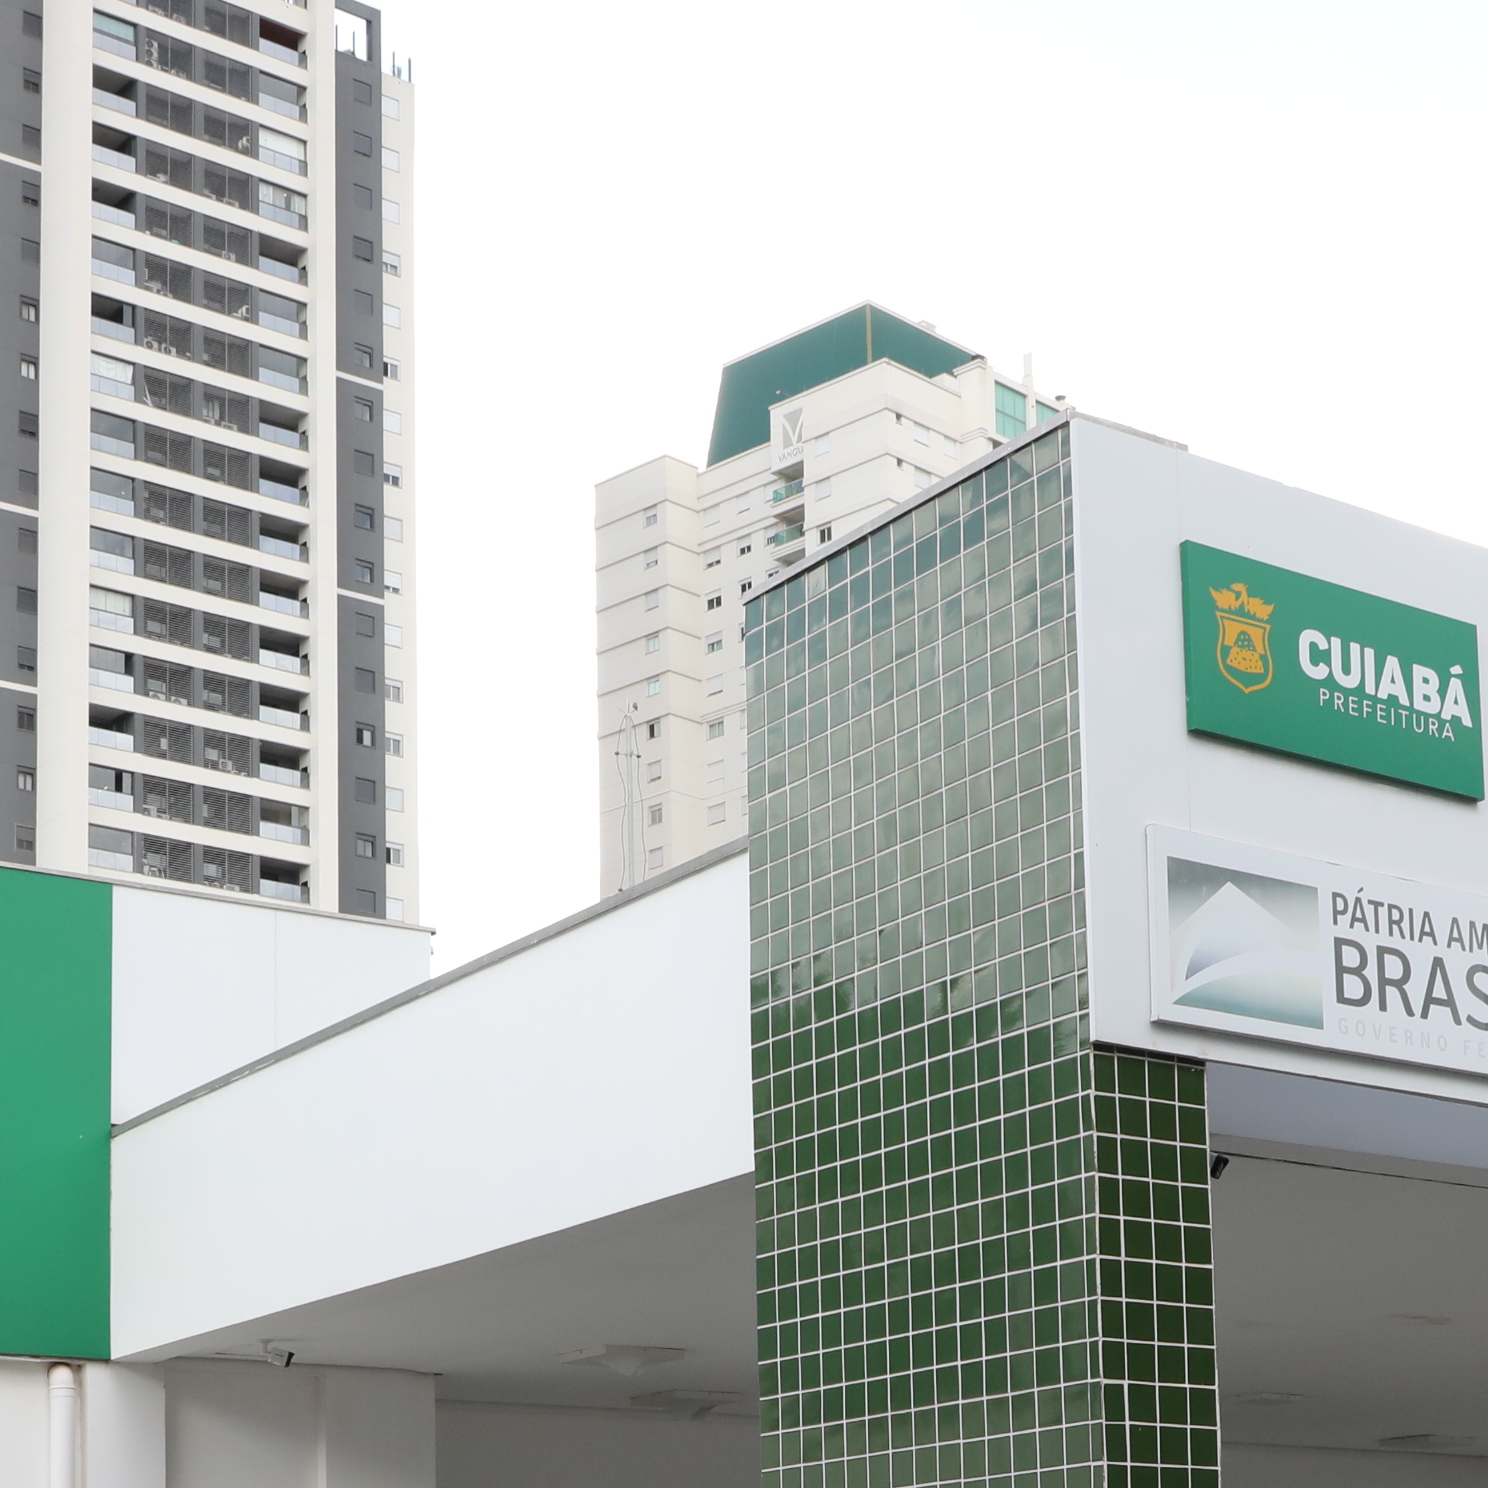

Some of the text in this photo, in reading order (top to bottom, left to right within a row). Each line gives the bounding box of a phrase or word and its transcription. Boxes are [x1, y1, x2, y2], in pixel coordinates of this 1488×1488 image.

[1298, 628, 1473, 728] CUIABÁ
[1319, 688, 1455, 742] PREFEITURA
[1331, 887, 1438, 946] PÁTRIA
[1337, 1017, 1448, 1052] GOVERNO
